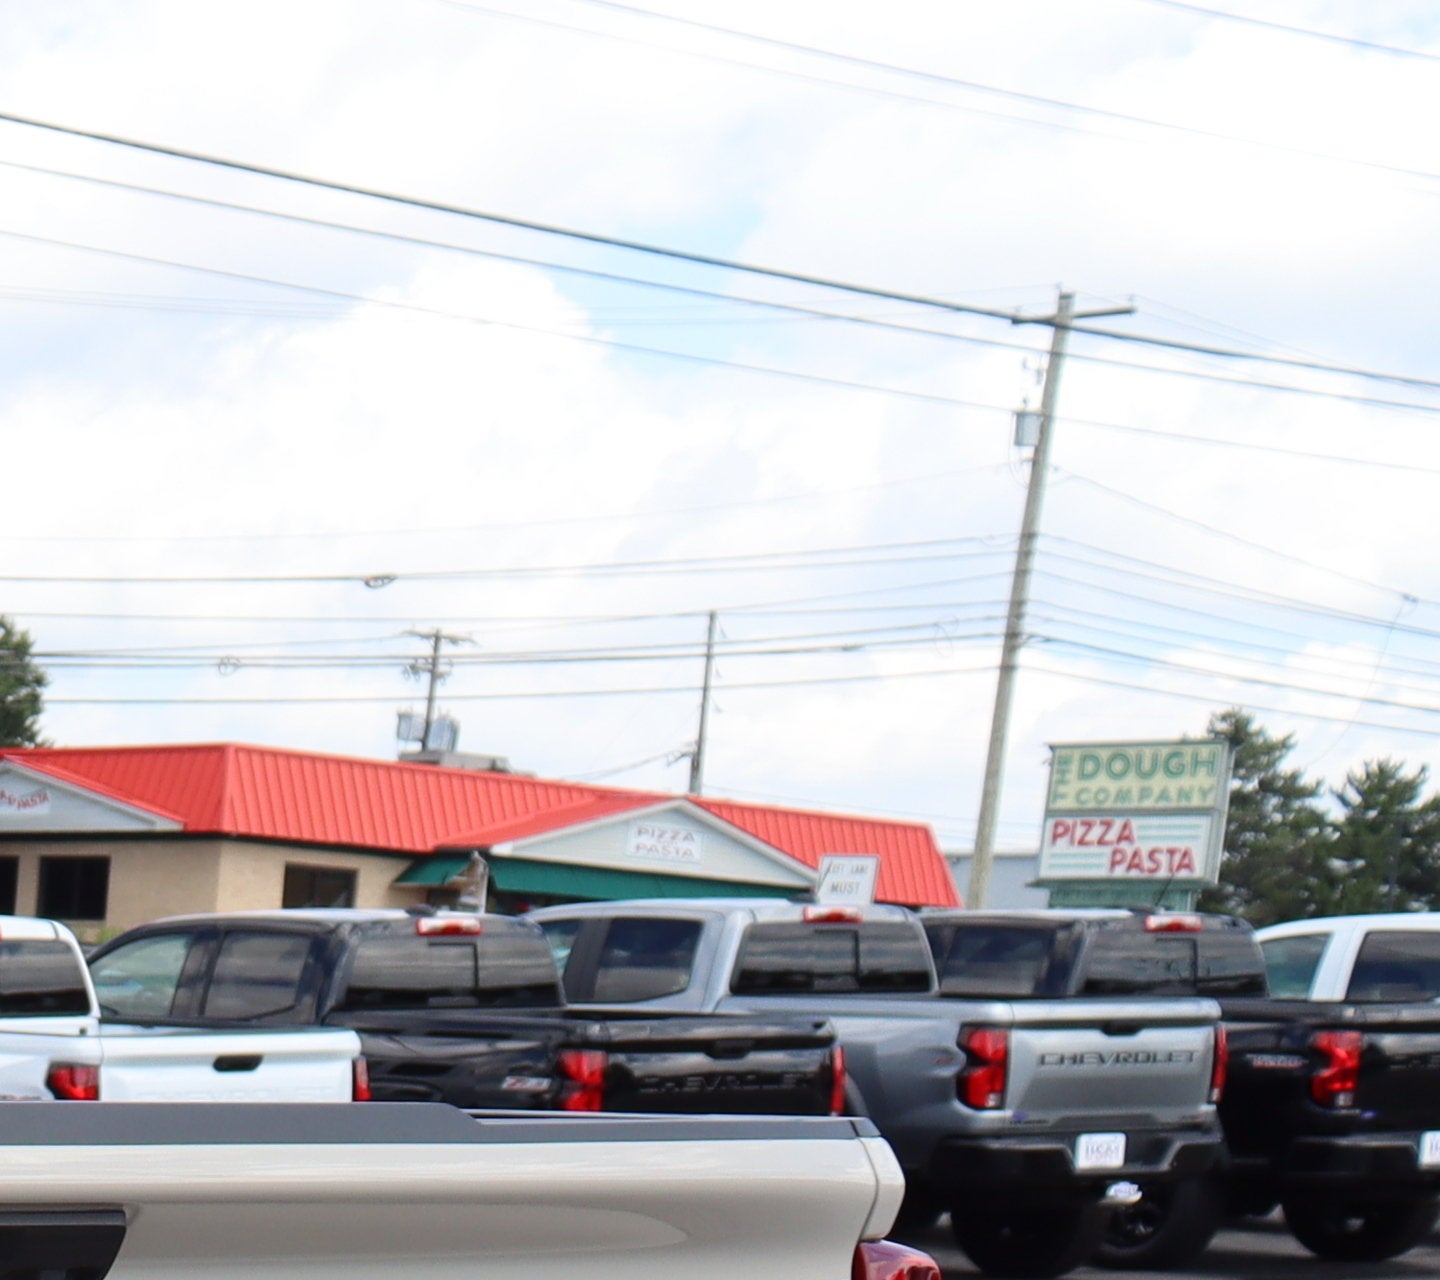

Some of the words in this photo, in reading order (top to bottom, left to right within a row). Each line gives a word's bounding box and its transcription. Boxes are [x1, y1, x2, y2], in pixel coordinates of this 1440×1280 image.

[1077, 750, 1218, 781] DOUGH
[1075, 784, 1215, 806] COMPANY
[636, 827, 696, 844] PIZZA
[1050, 818, 1136, 846] PIZZA
[635, 843, 694, 859] PASTA
[1108, 846, 1197, 874] PASTA
[1038, 1051, 1199, 1067] CHEVROLET
